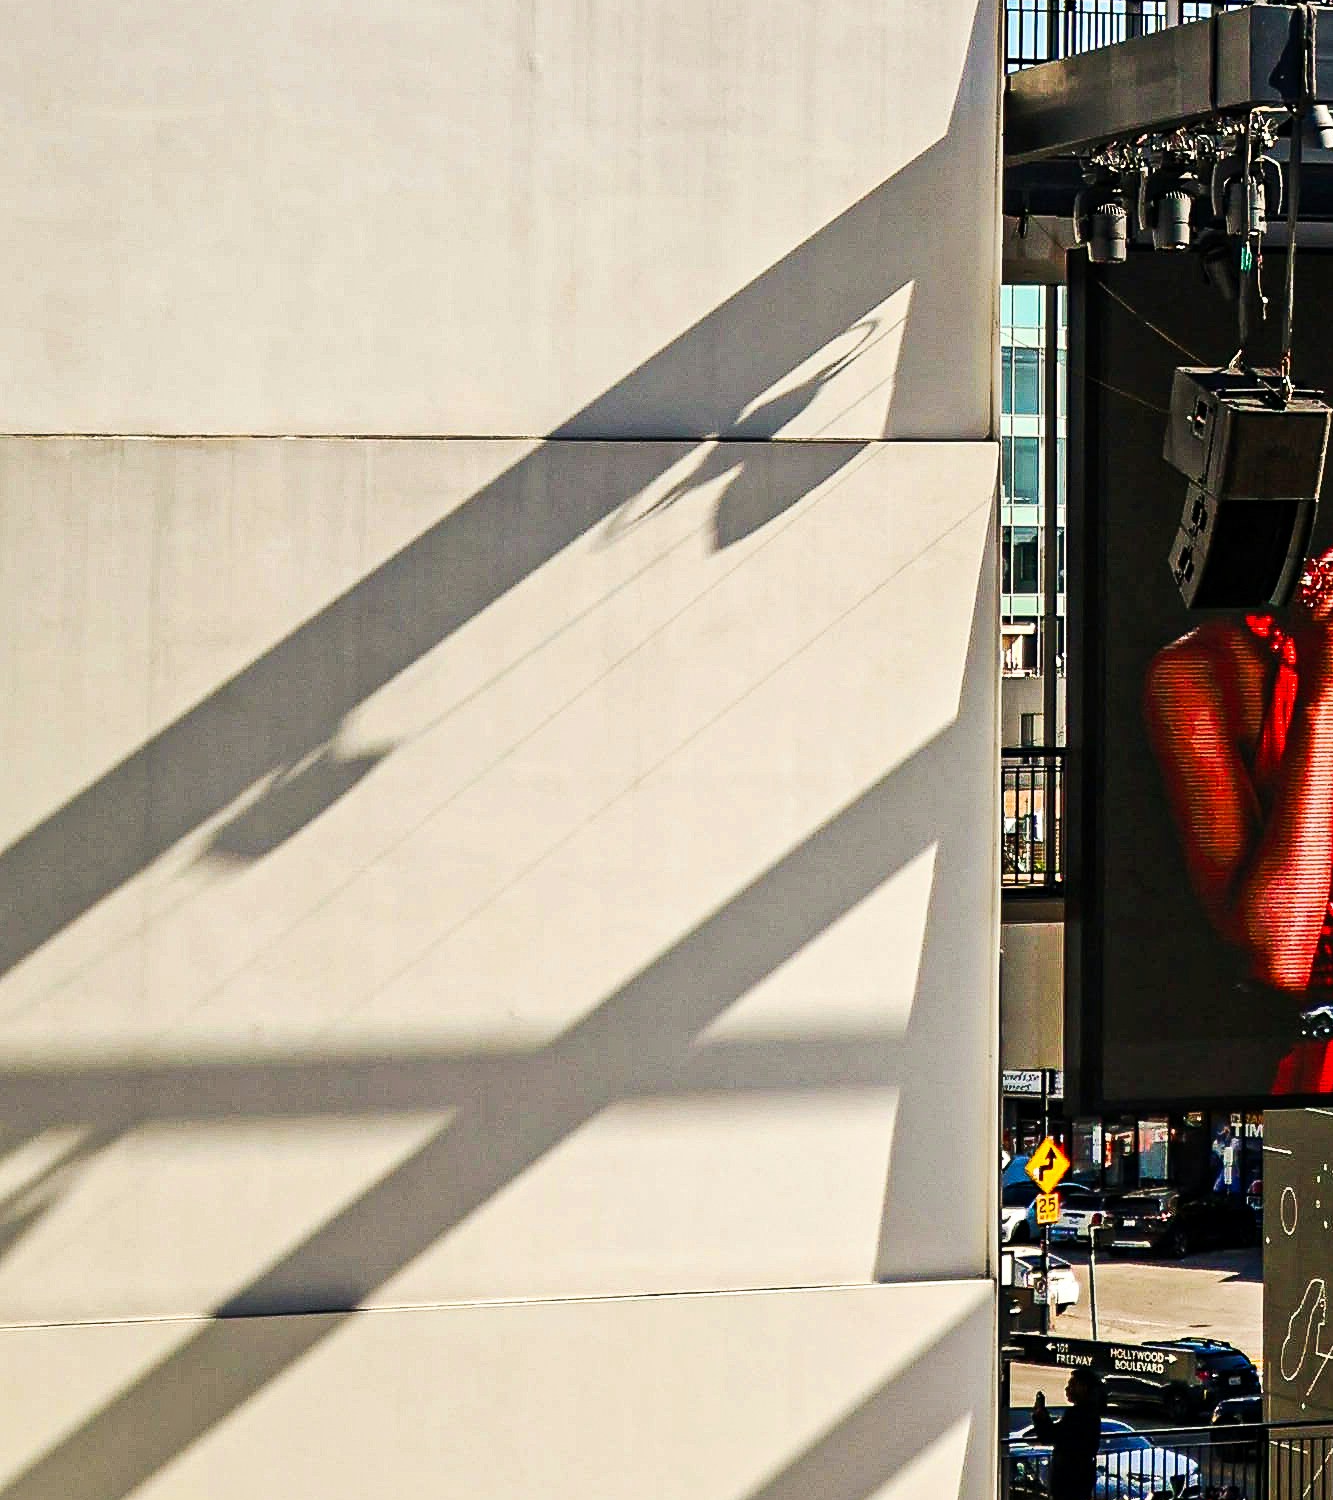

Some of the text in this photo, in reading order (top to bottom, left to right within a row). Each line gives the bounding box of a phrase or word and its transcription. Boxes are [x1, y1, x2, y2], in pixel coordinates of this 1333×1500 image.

[1039, 1197, 1055, 1213] 25
[1057, 1354, 1093, 1367] FREEWAY
[1110, 1348, 1165, 1363] HOLLYWOOD
[1115, 1360, 1165, 1374] BOULEVARD
